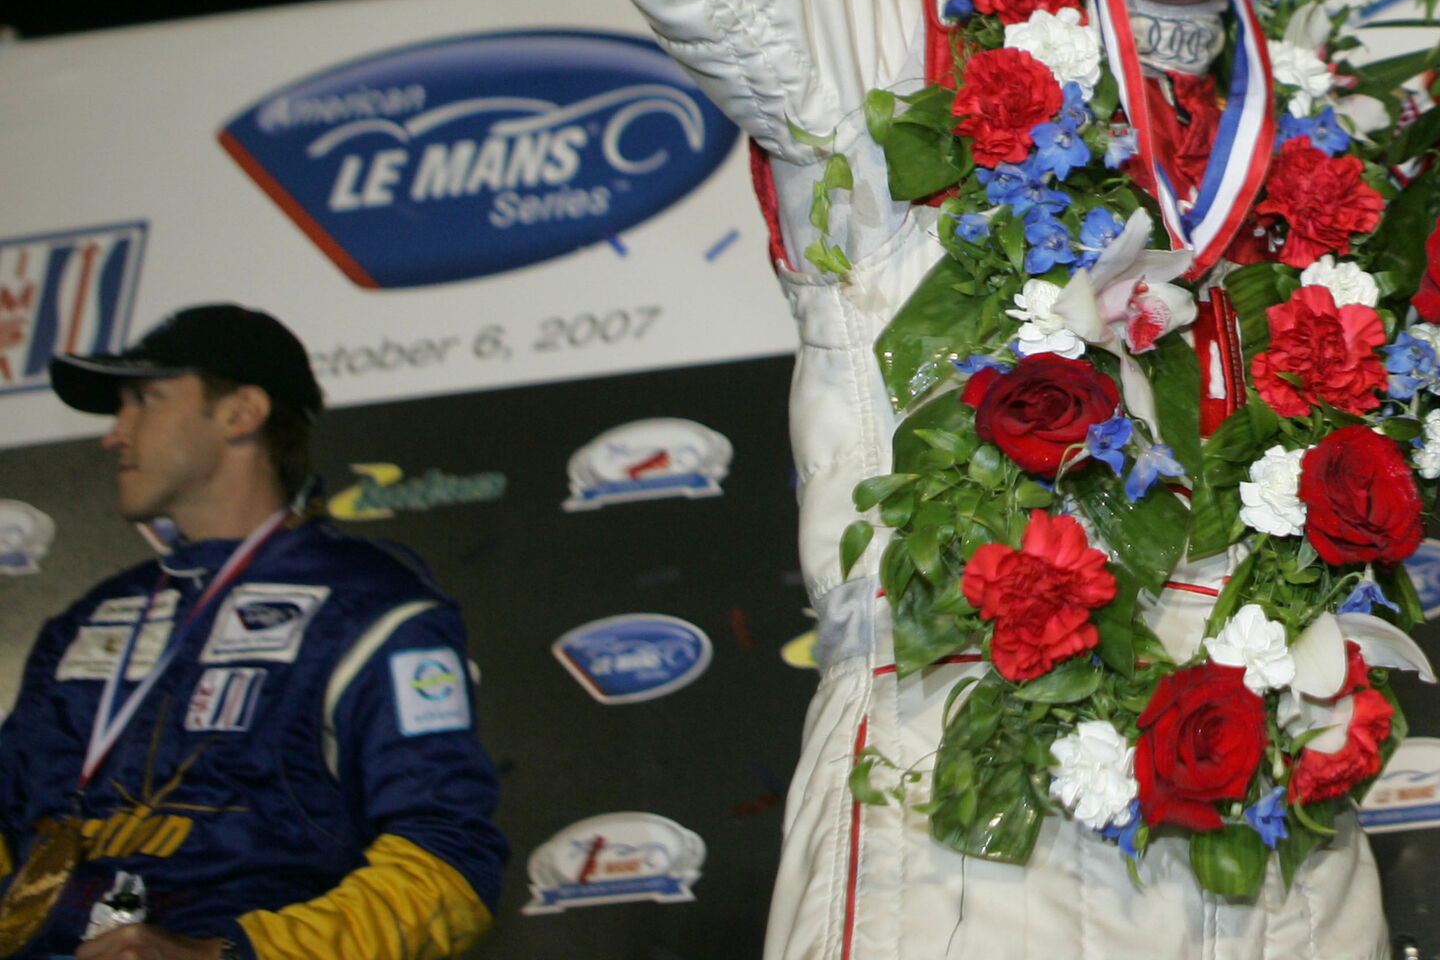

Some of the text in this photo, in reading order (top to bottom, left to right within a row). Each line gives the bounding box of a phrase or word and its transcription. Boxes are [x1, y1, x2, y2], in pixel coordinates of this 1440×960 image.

[328, 125, 588, 212] LE MANS
[488, 185, 612, 229] Series
[312, 304, 663, 378] ctober 6, 2007
